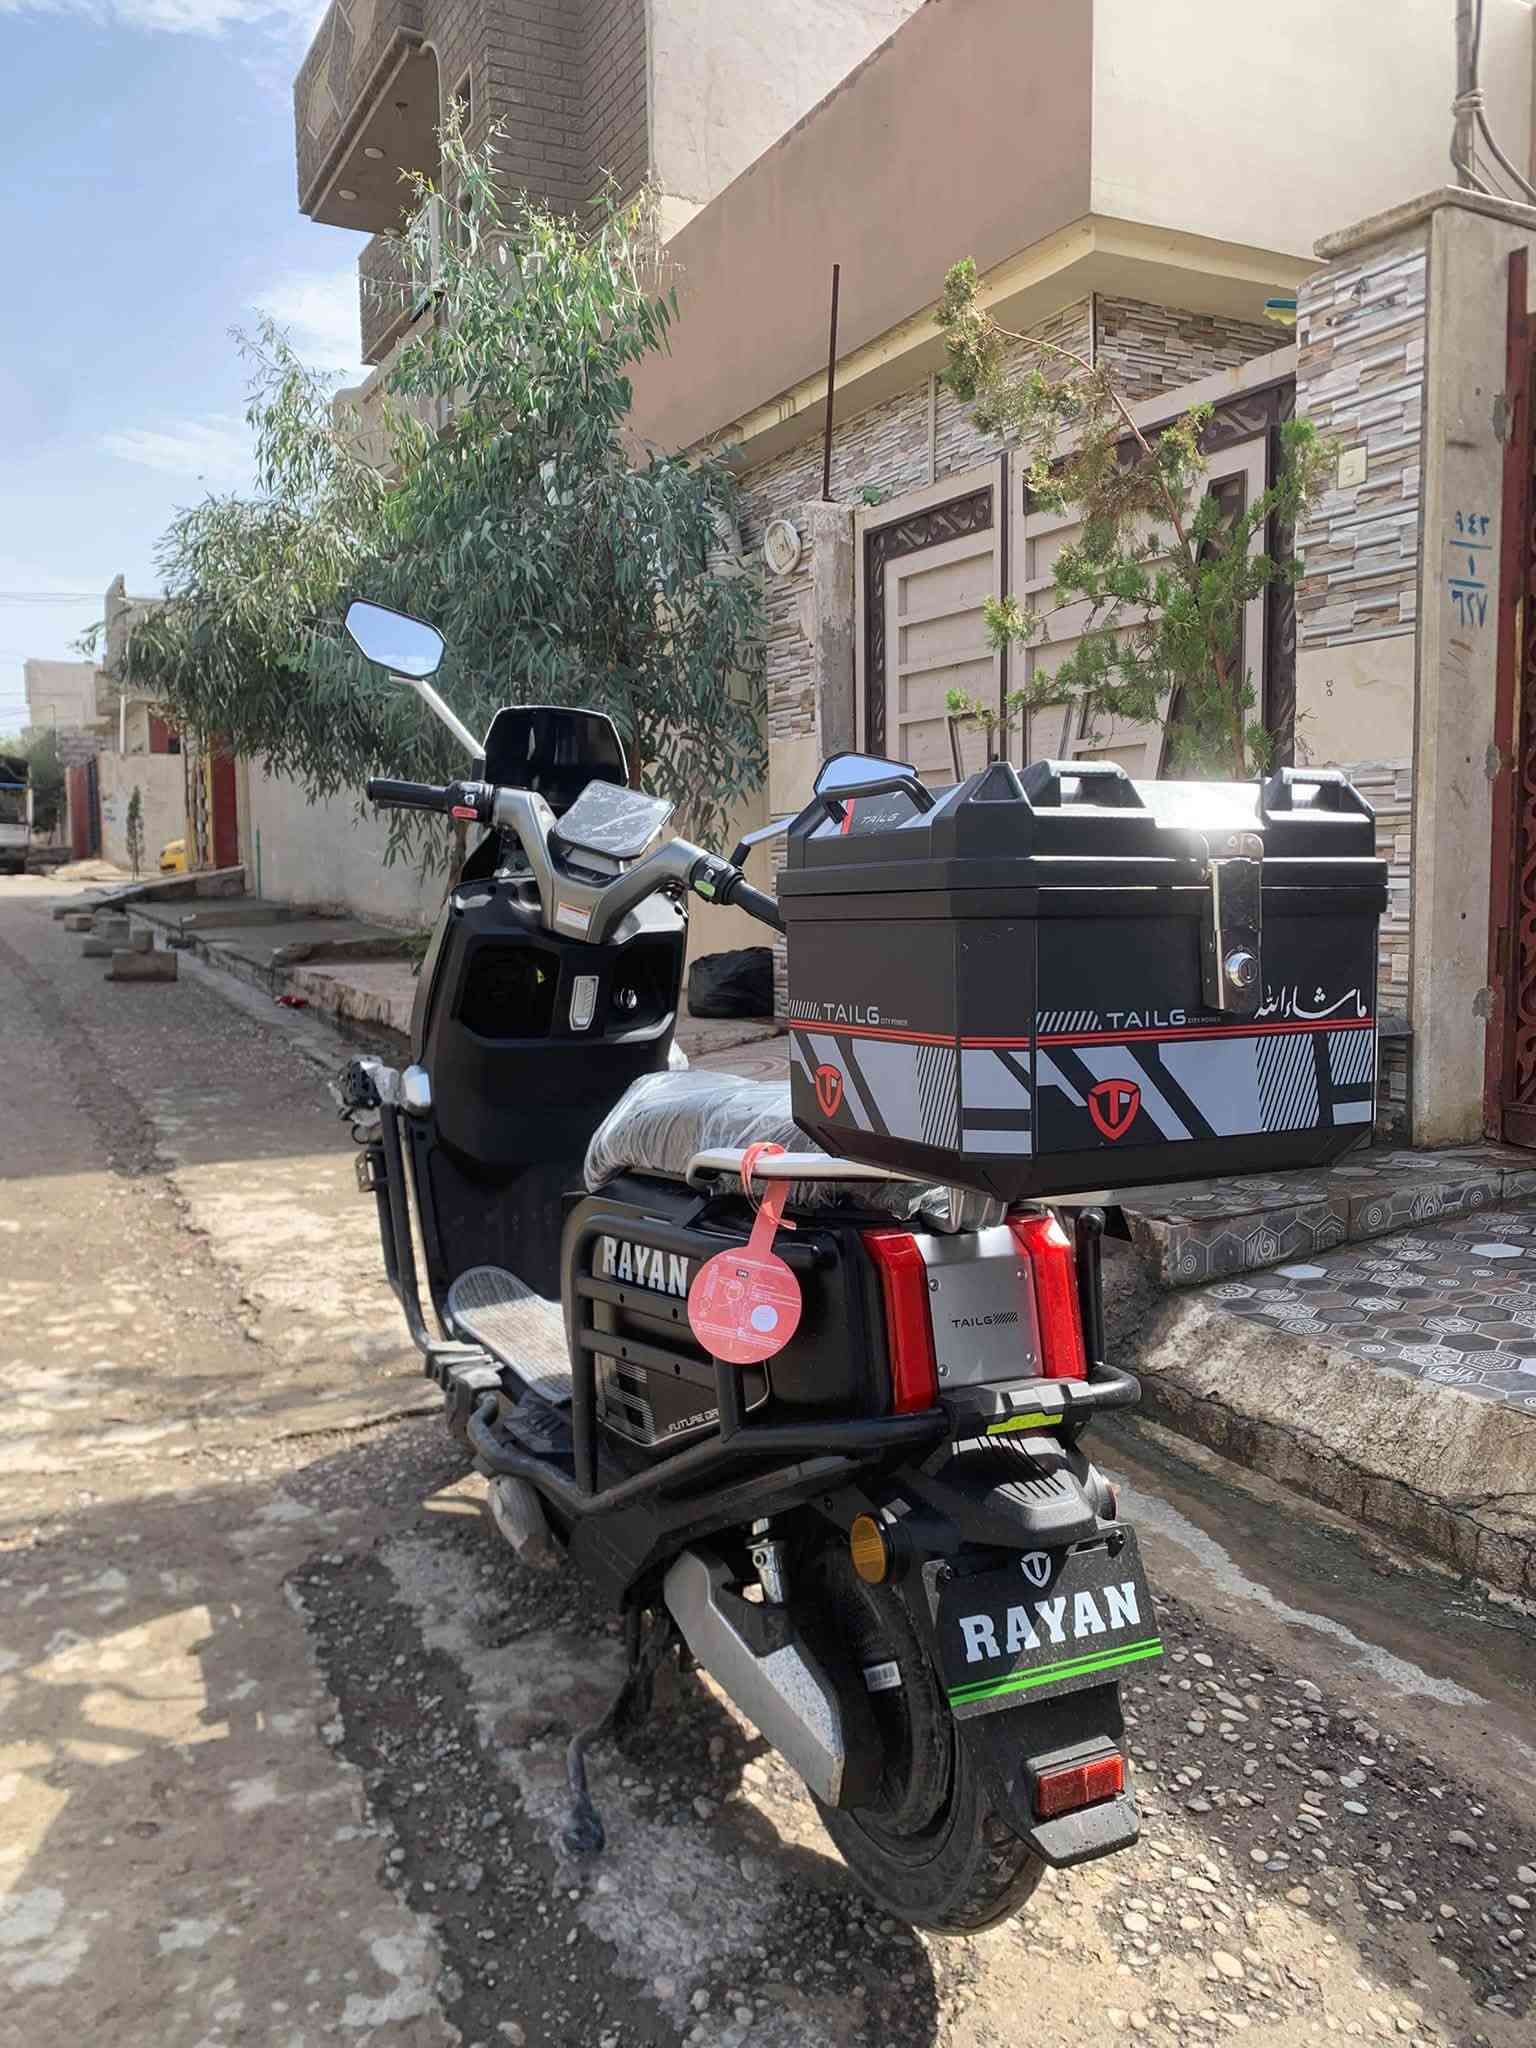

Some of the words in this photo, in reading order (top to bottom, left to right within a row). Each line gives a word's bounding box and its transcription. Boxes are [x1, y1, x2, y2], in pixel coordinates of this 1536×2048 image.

[823, 1003, 880, 1025] TAILG
[1106, 1009, 1186, 1029] TAILG
[602, 1235, 689, 1298] RAYAN
[952, 1315, 993, 1328] TAILG
[958, 1581, 1142, 1664] RAYAN
